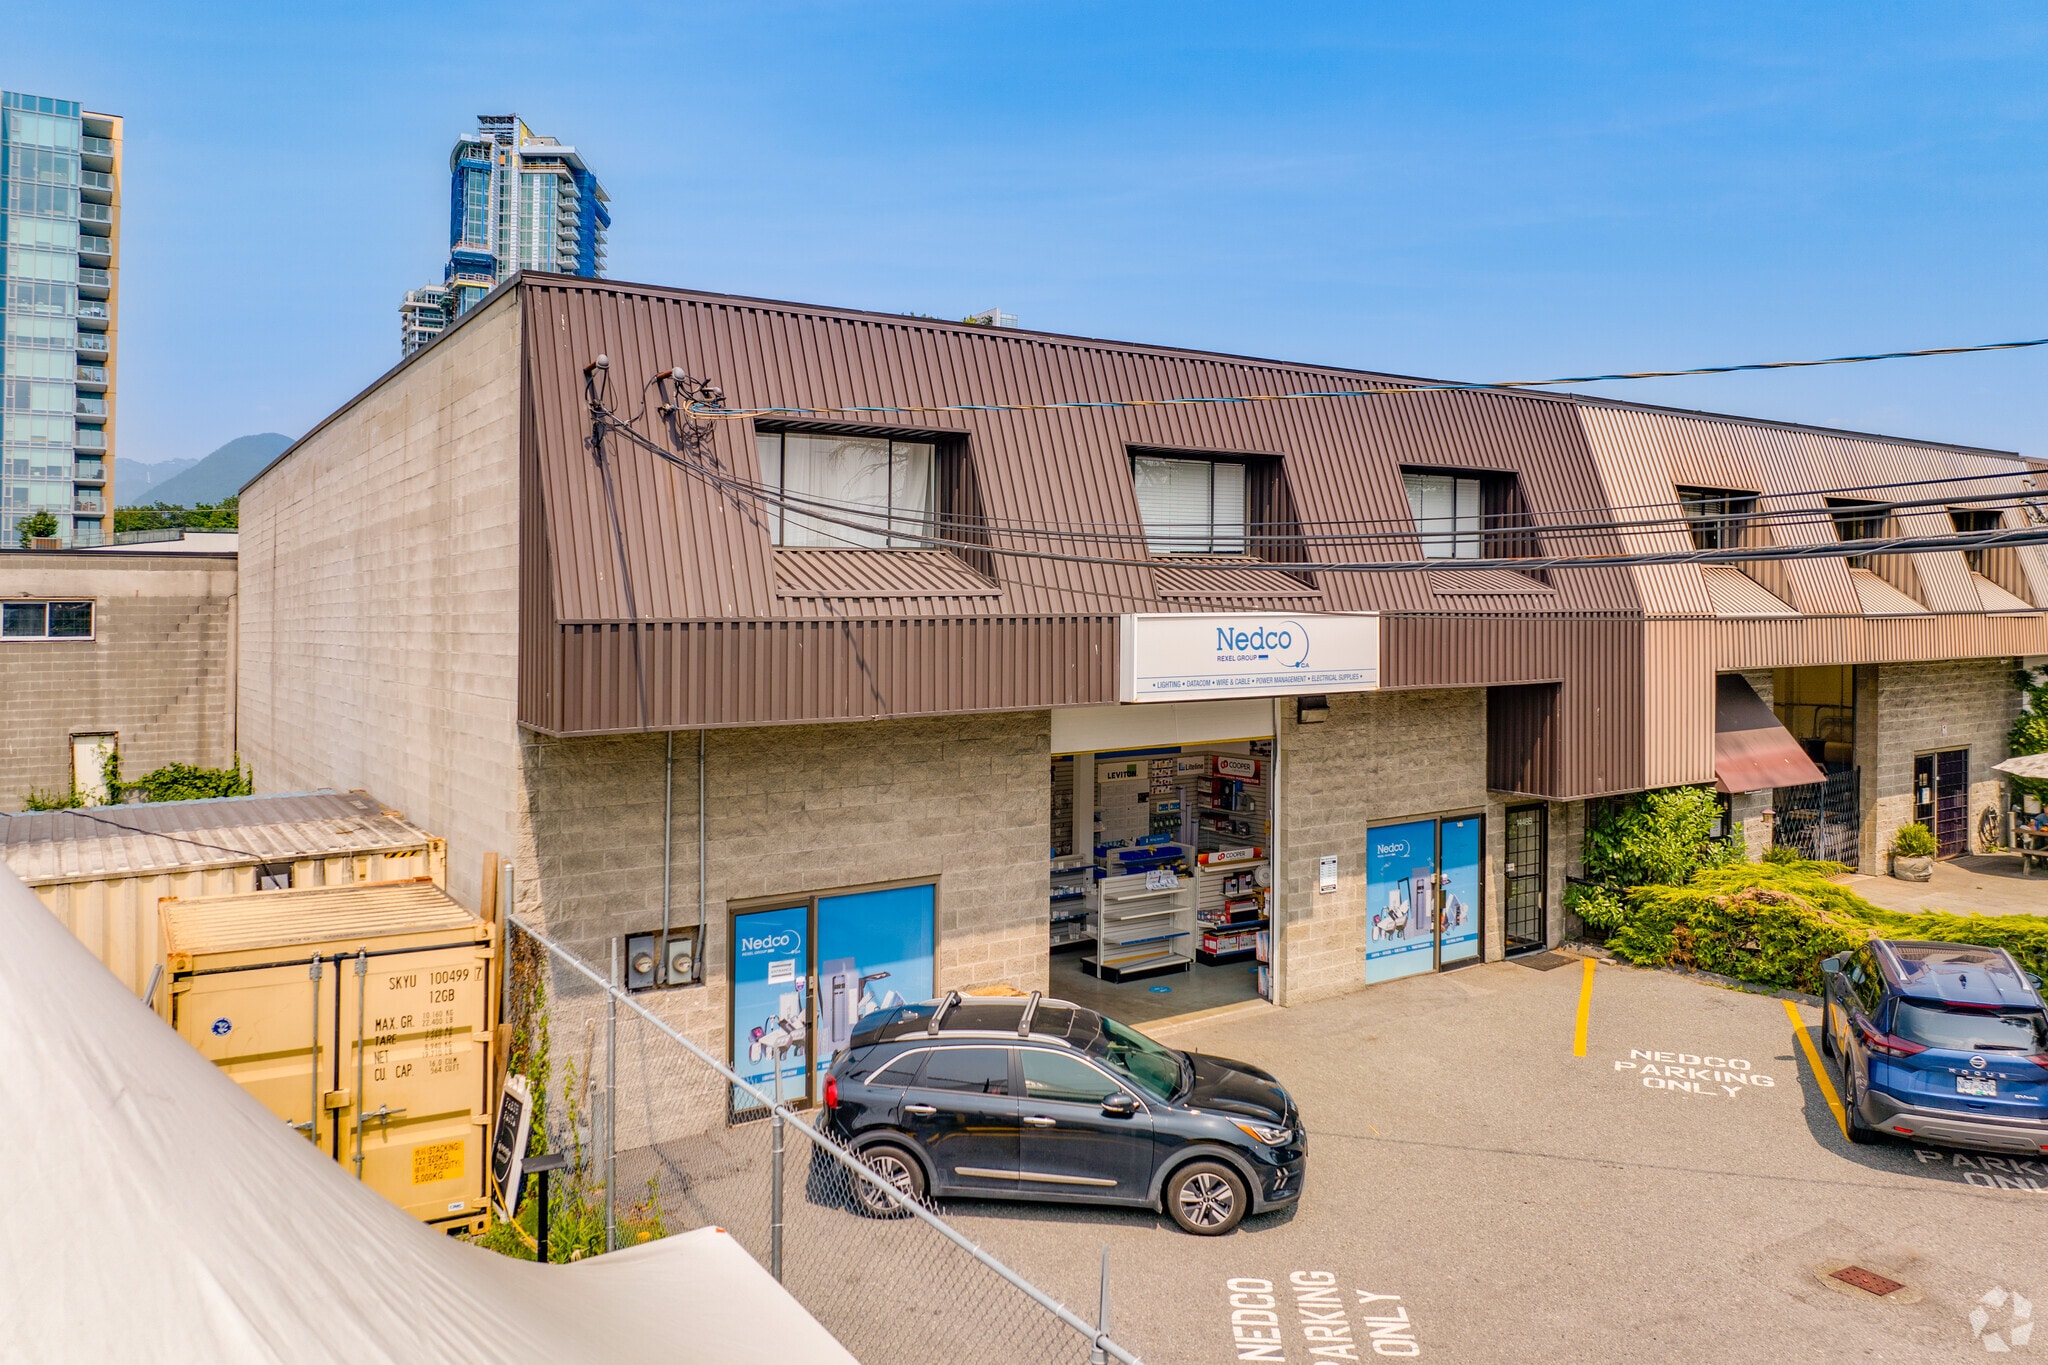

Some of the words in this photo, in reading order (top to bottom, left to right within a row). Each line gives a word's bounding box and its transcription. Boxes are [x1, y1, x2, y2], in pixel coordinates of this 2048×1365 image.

[1216, 626, 1292, 651] Nedco
[1157, 681, 1181, 689] LIGHTING
[1186, 679, 1211, 688] DATACOM
[1216, 678, 1229, 686] WIRE
[1235, 677, 1251, 685] CABLE
[1274, 675, 1306, 683] MANAGEMENT
[1311, 674, 1337, 682] ELECTRICAL
[1338, 673, 1359, 681] SUPPLIES
[1185, 761, 1204, 771] Liteline
[1229, 761, 1251, 770] COOPER
[1107, 770, 1138, 780] LEVITON
[1225, 850, 1246, 859] COOPER
[1377, 843, 1404, 855] Nedco
[741, 934, 790, 952] Nedco
[389, 974, 417, 990] SKYU
[430, 968, 470, 986] 100499
[475, 966, 483, 981] 7
[430, 988, 455, 1004] 12GB
[375, 1033, 397, 1047] TARE
[374, 1049, 389, 1065] NET
[1630, 1049, 1751, 1071] NEDCO
[1614, 1060, 1775, 1088] PARKING
[1948, 1066, 2007, 1080] ROGUE
[1643, 1077, 1743, 1098] ONLY
[1226, 1277, 1286, 1363] NEDCO
[1289, 1270, 1360, 1365] ARKING
[1356, 1288, 1421, 1357] ONLY
